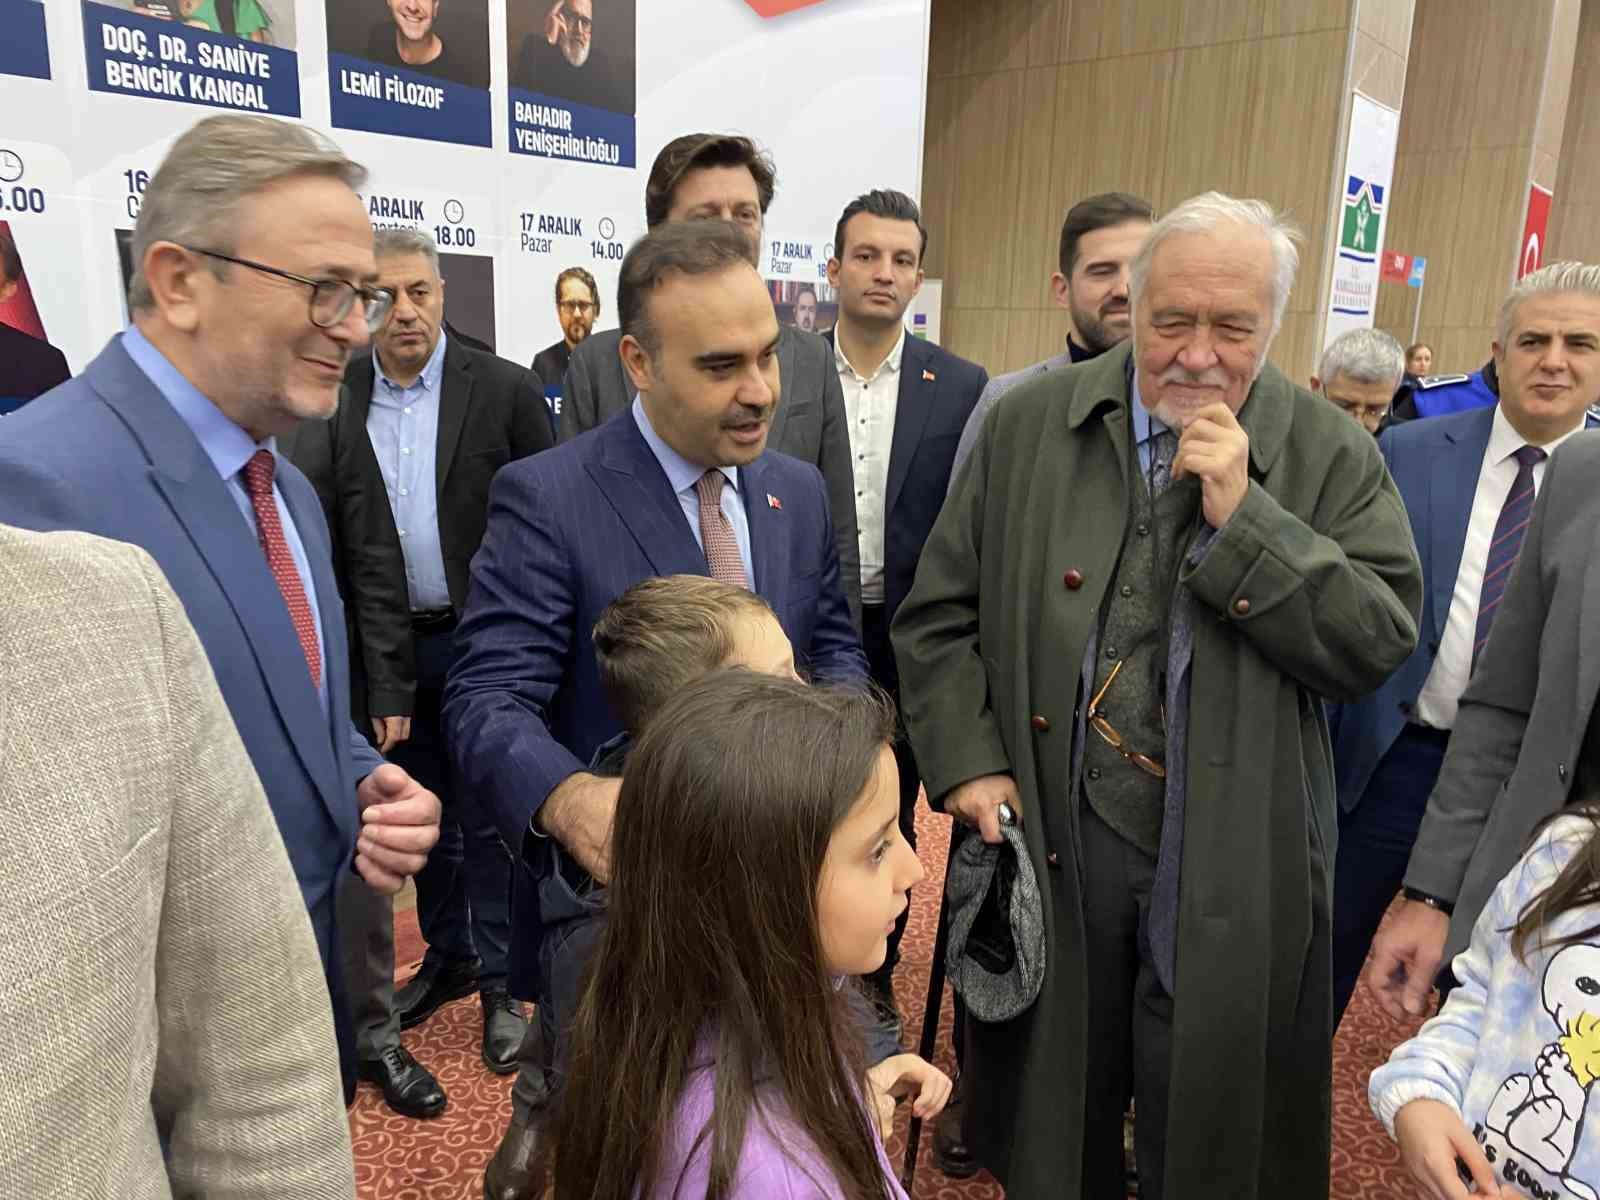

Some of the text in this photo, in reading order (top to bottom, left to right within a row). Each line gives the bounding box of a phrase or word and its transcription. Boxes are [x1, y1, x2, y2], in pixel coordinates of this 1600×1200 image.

[102, 23, 270, 79] DOÇ. DR. SANİYE
[106, 61, 269, 110] BENCİK KANGAL
[341, 69, 444, 110] LEMİ FİLOZOF
[515, 101, 571, 130] BAHADIR
[515, 128, 619, 163] YENİŞEHİRLİOĞLU
[369, 195, 424, 221] ARALIK
[434, 225, 476, 248] 18.00
[520, 213, 582, 236] 17 ARALIK
[520, 233, 552, 254] Pazar
[590, 242, 624, 260] 14.00
[771, 241, 813, 260] 17 ARALIK
[771, 258, 792, 273] Pazar
